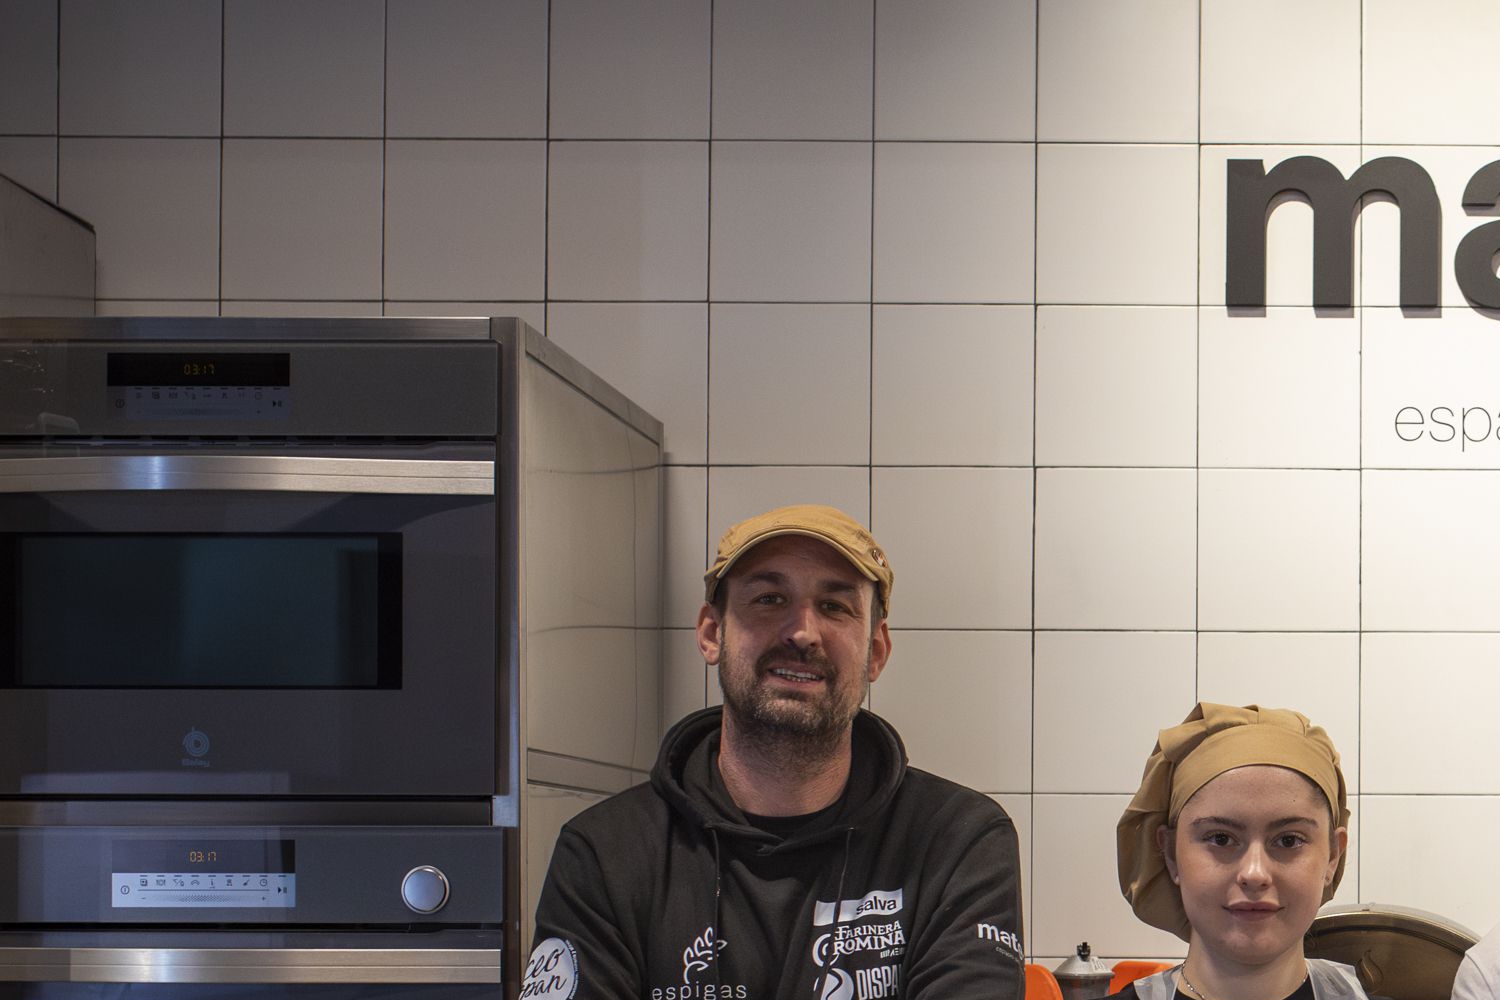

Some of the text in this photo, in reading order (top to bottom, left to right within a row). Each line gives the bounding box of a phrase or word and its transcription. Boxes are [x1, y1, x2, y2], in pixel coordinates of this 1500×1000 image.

[188, 851, 217, 862] 03:17
[856, 895, 897, 915] salva
[834, 919, 902, 941] FARINERA
